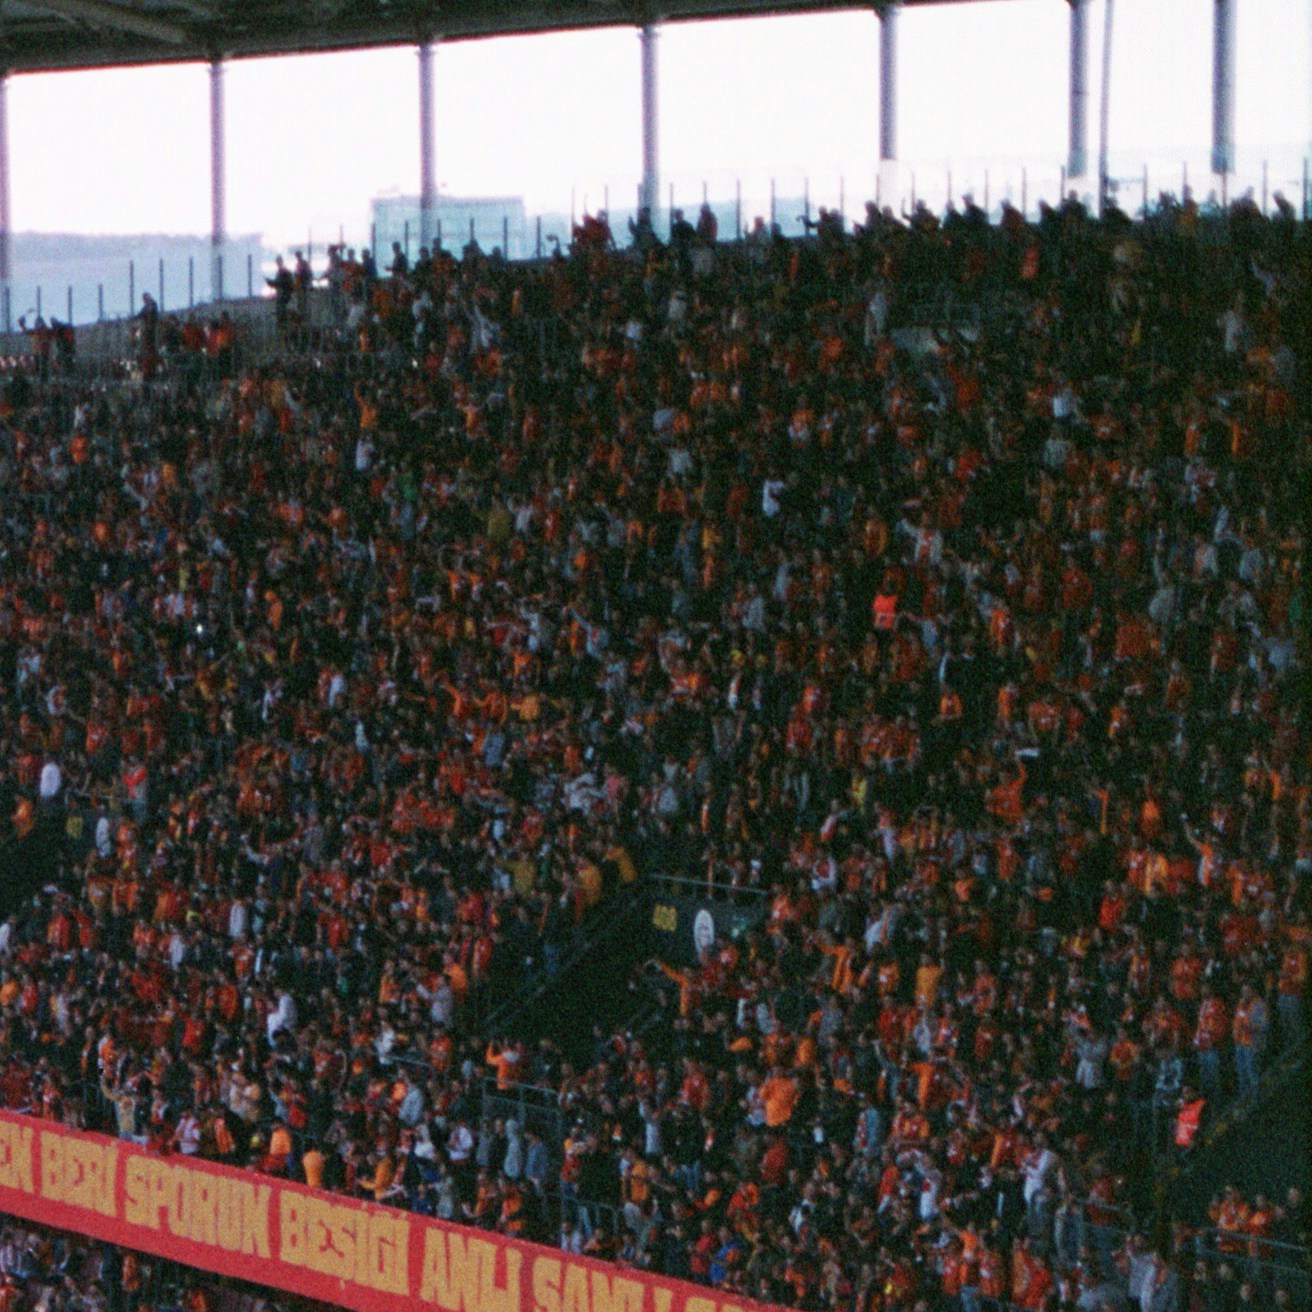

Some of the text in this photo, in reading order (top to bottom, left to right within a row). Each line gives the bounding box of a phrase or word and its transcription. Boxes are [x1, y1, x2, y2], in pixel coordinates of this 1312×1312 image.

[40, 1129, 119, 1217] BERİ
[124, 1155, 272, 1259] SPORUN
[279, 1188, 411, 1296] BEŞİĞİ
